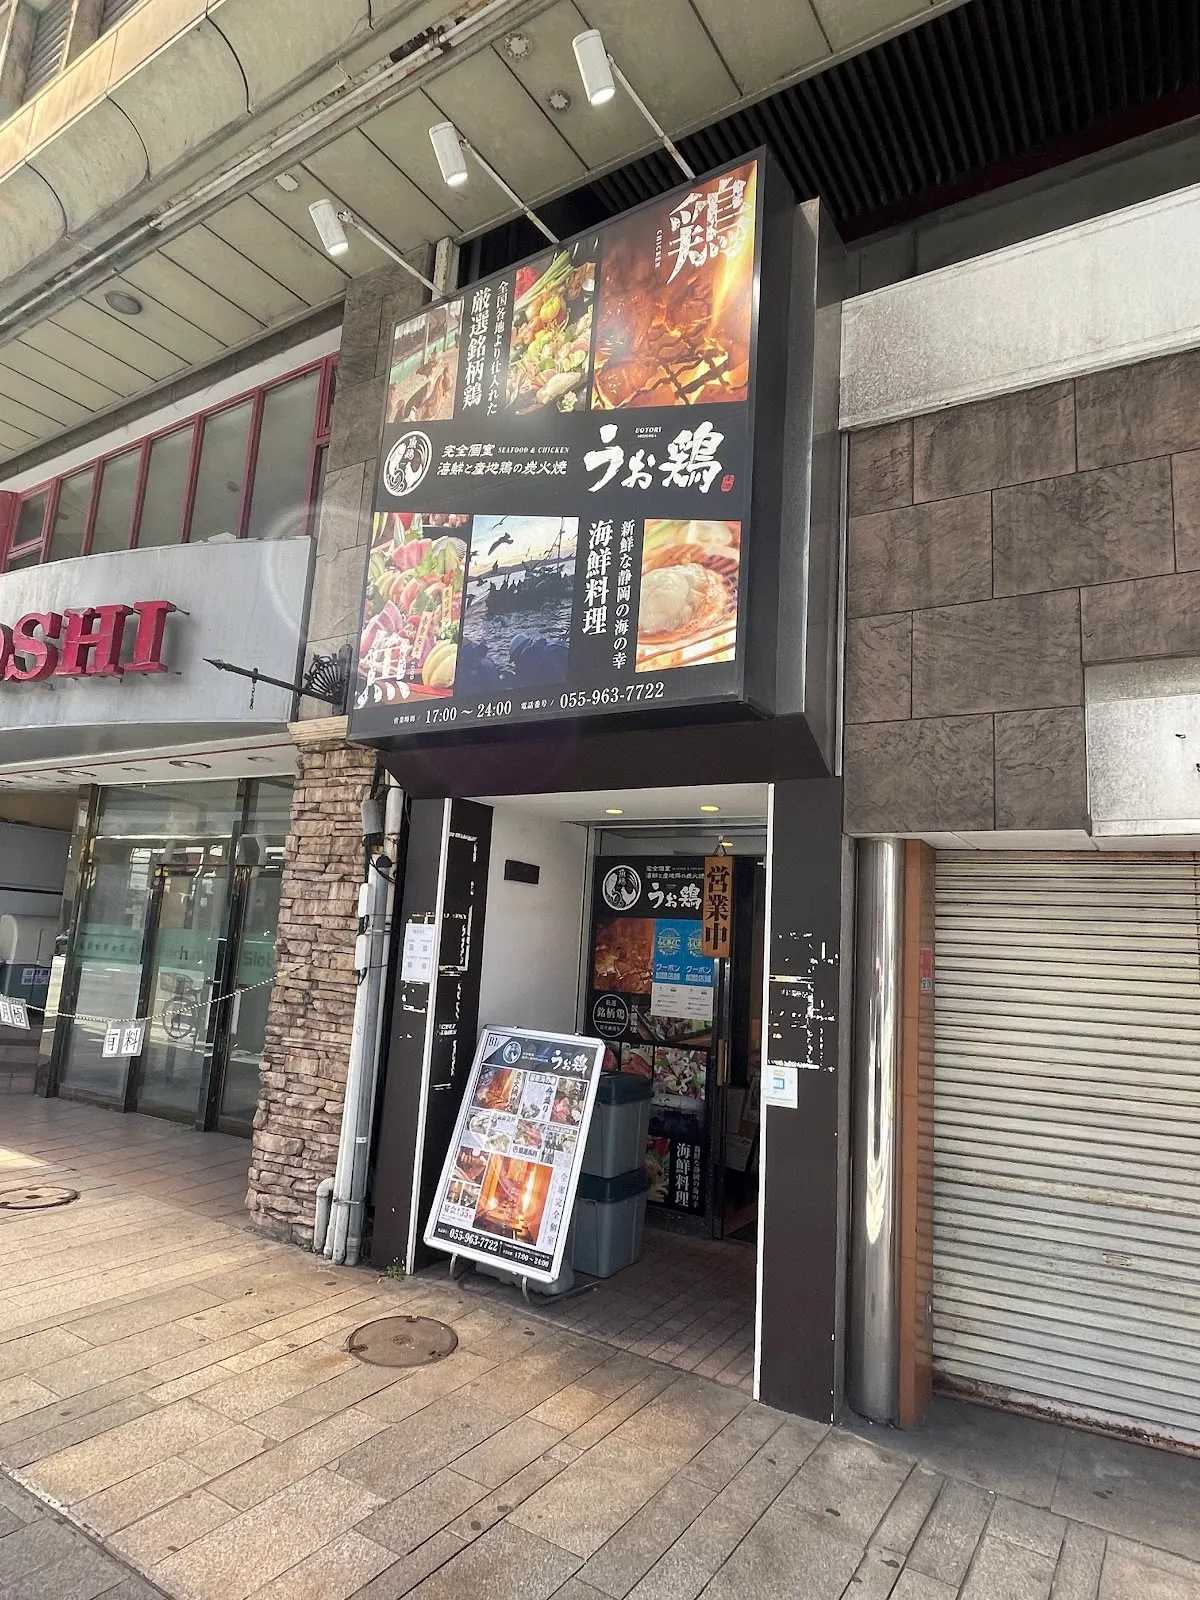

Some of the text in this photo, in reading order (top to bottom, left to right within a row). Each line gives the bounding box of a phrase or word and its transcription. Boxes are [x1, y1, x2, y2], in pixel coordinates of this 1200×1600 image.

[655, 229, 664, 268] CHICKEN
[462, 287, 492, 410] 厳選銘柄鶏
[487, 281, 509, 416] 全国各地より仕入れた
[441, 443, 496, 458] 完全個室
[497, 446, 529, 454] SEAFOOD
[537, 446, 570, 454] CHICKEN
[583, 421, 725, 493] うお鶏
[436, 460, 568, 476] 海鮮と産地鶏の炭火焼
[581, 518, 614, 636] 海鮮料理
[612, 519, 636, 669] 新鮮な静岡の海の幸
[560, 681, 665, 709] 055-963-7722
[425, 706, 457, 724] 17:00
[476, 700, 512, 718] 24:00
[647, 882, 702, 910] うお鶏
[705, 865, 731, 950] 営業中
[655, 963, 712, 974] クーポン クーポン
[596, 1006, 625, 1020] 銘柄鶏
[551, 1049, 588, 1074] うお鶏
[674, 1142, 691, 1207] 海鮮料理
[450, 1228, 498, 1251] 055-963-7722
[514, 1251, 529, 1261] 17:00
